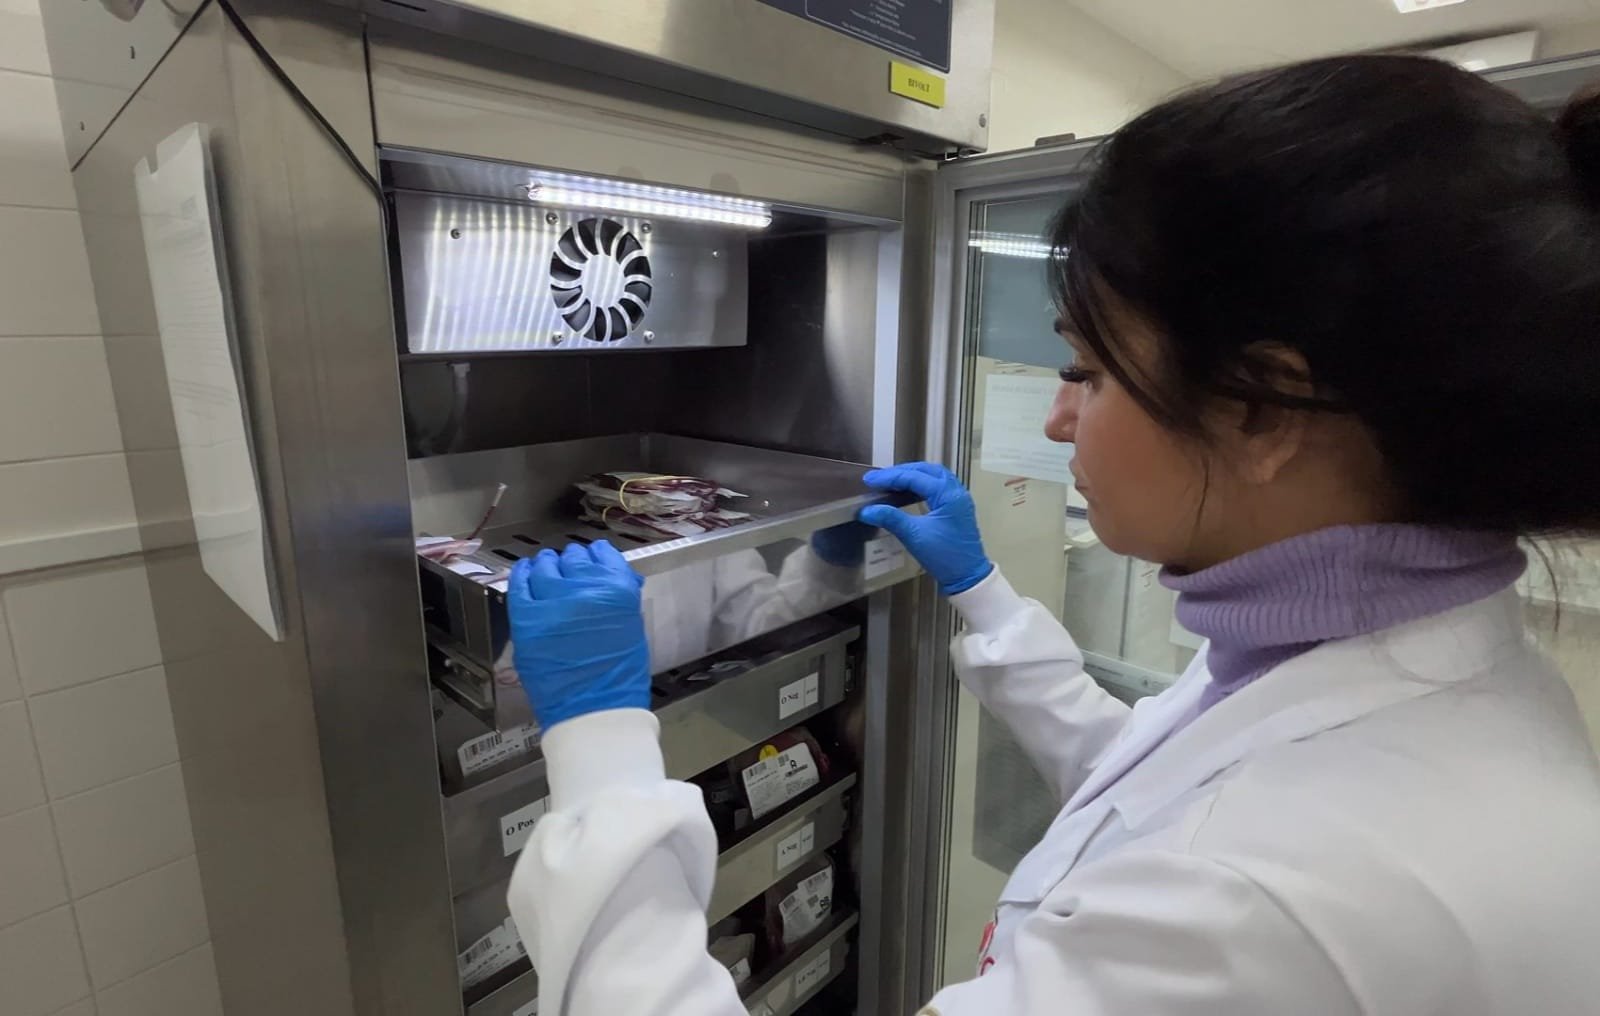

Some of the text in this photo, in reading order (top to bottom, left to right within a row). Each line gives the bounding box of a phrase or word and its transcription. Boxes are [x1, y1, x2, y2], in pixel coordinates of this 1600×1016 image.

[781, 696, 787, 704] O
[506, 819, 535, 836] O Pos
